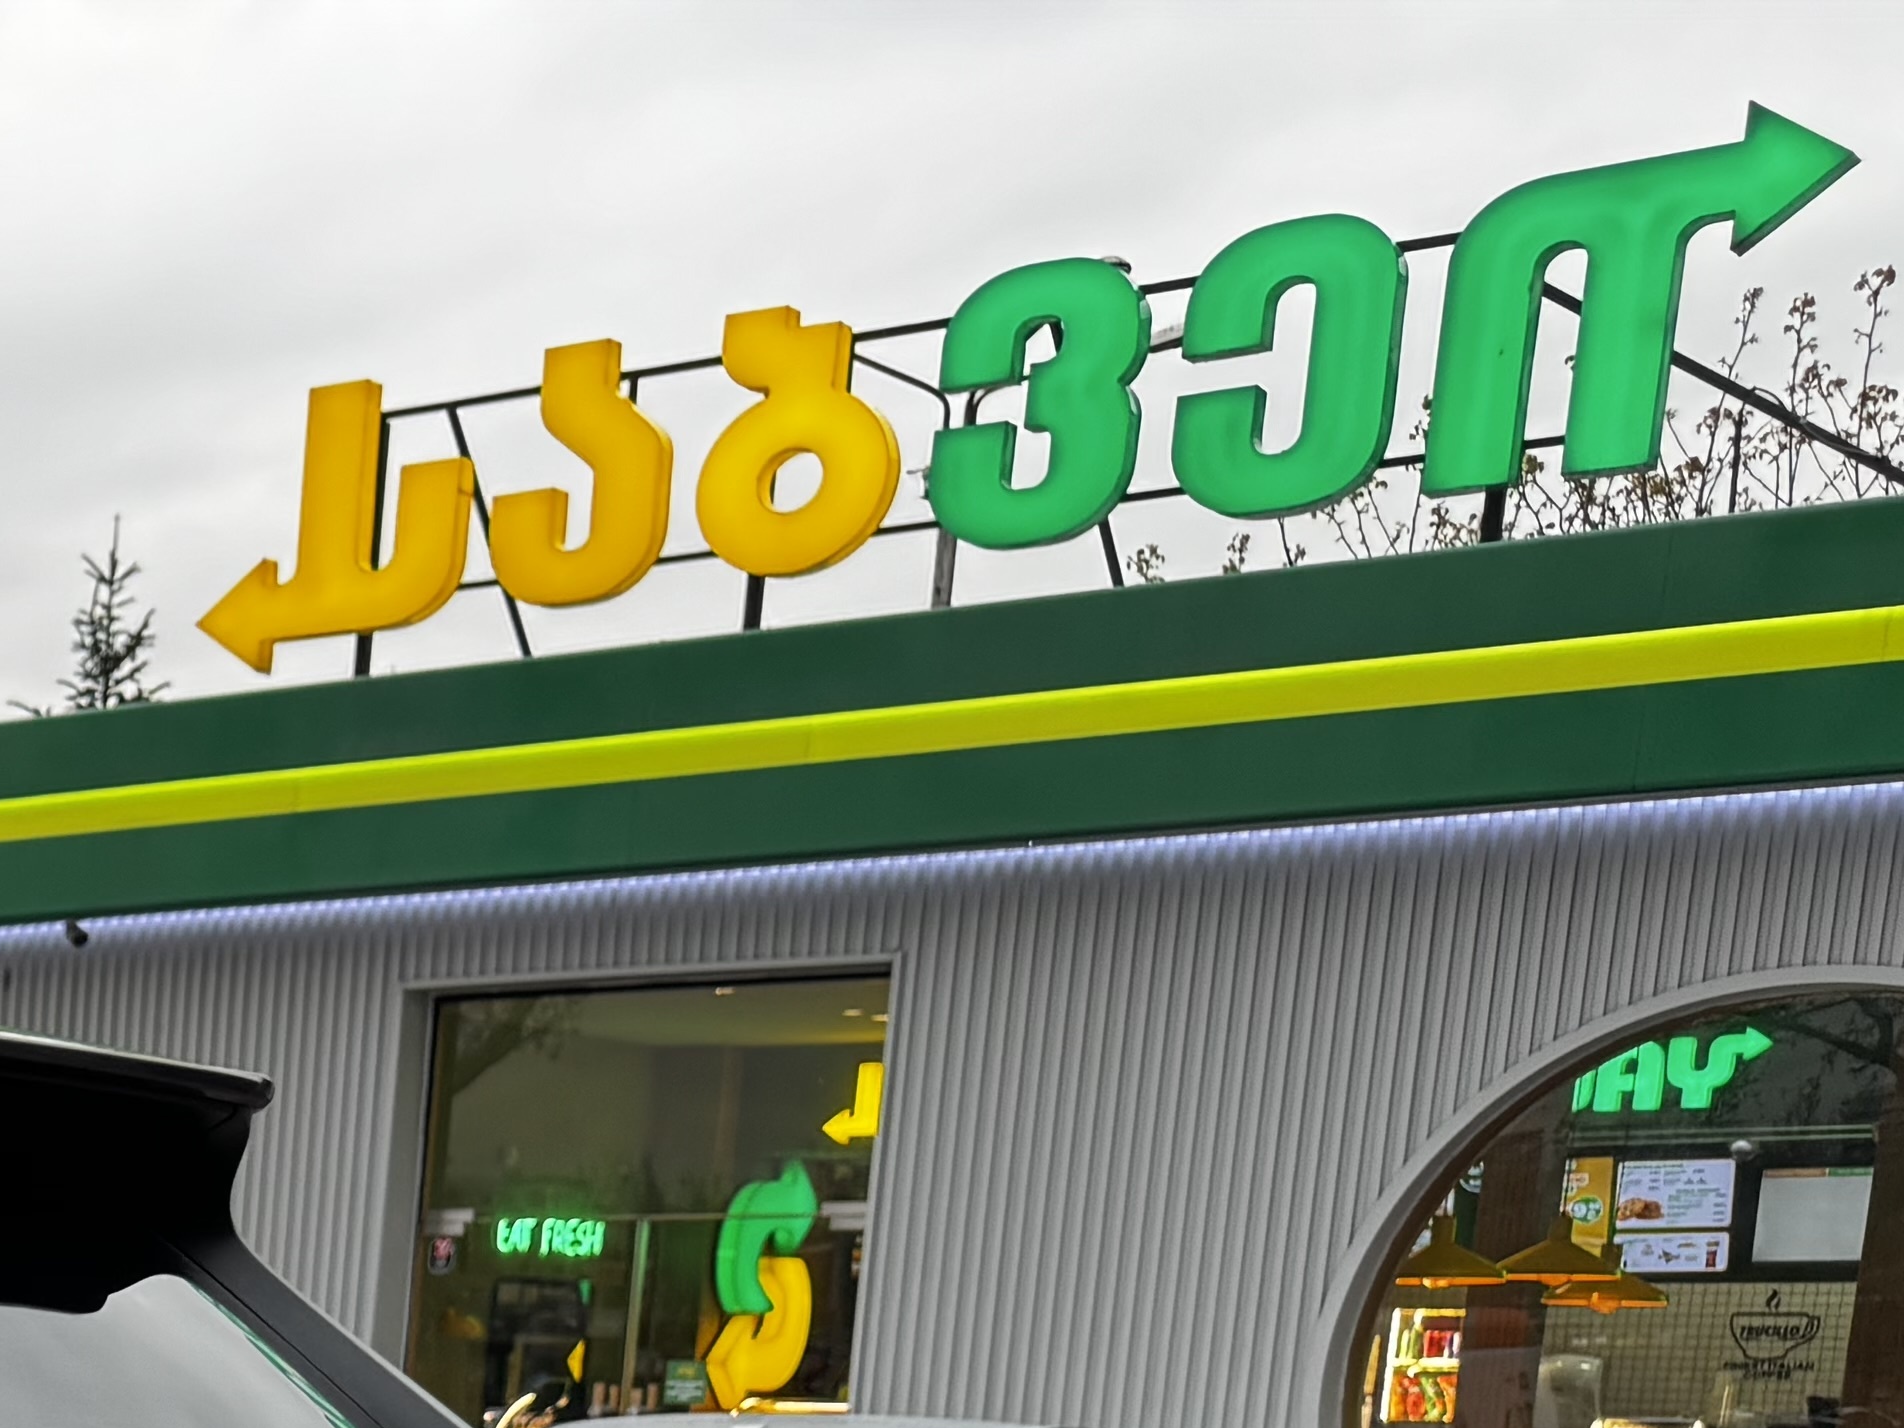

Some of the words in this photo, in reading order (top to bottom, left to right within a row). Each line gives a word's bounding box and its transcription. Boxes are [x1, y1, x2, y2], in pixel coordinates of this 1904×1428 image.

[194, 101, 1860, 674] საბვეი
[496, 1217, 538, 1254] EAT
[538, 1217, 606, 1257] FRESH
